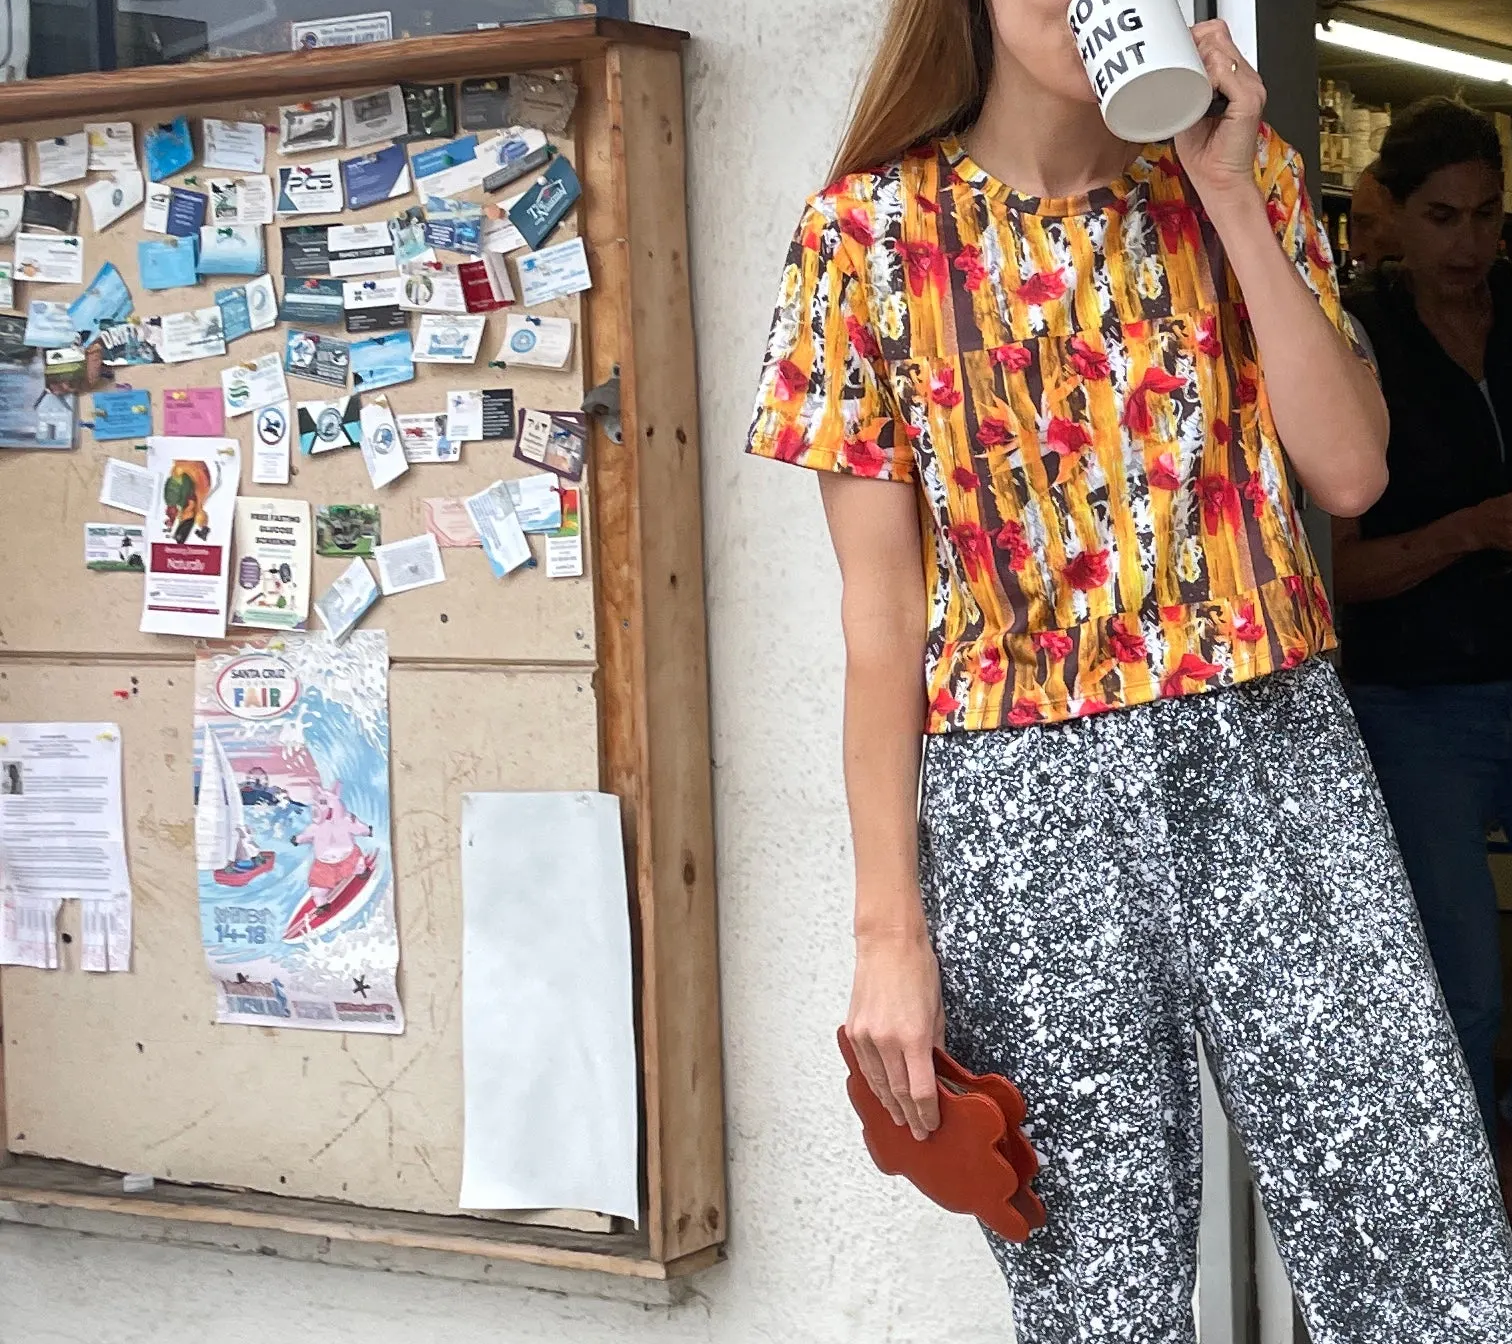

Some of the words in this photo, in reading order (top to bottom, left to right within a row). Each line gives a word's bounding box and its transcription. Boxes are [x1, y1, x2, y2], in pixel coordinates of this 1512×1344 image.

[1094, 40, 1146, 105] ENT
[231, 669, 261, 679] SANTA
[262, 669, 286, 679] CRUZ
[233, 687, 282, 708] FAIR
